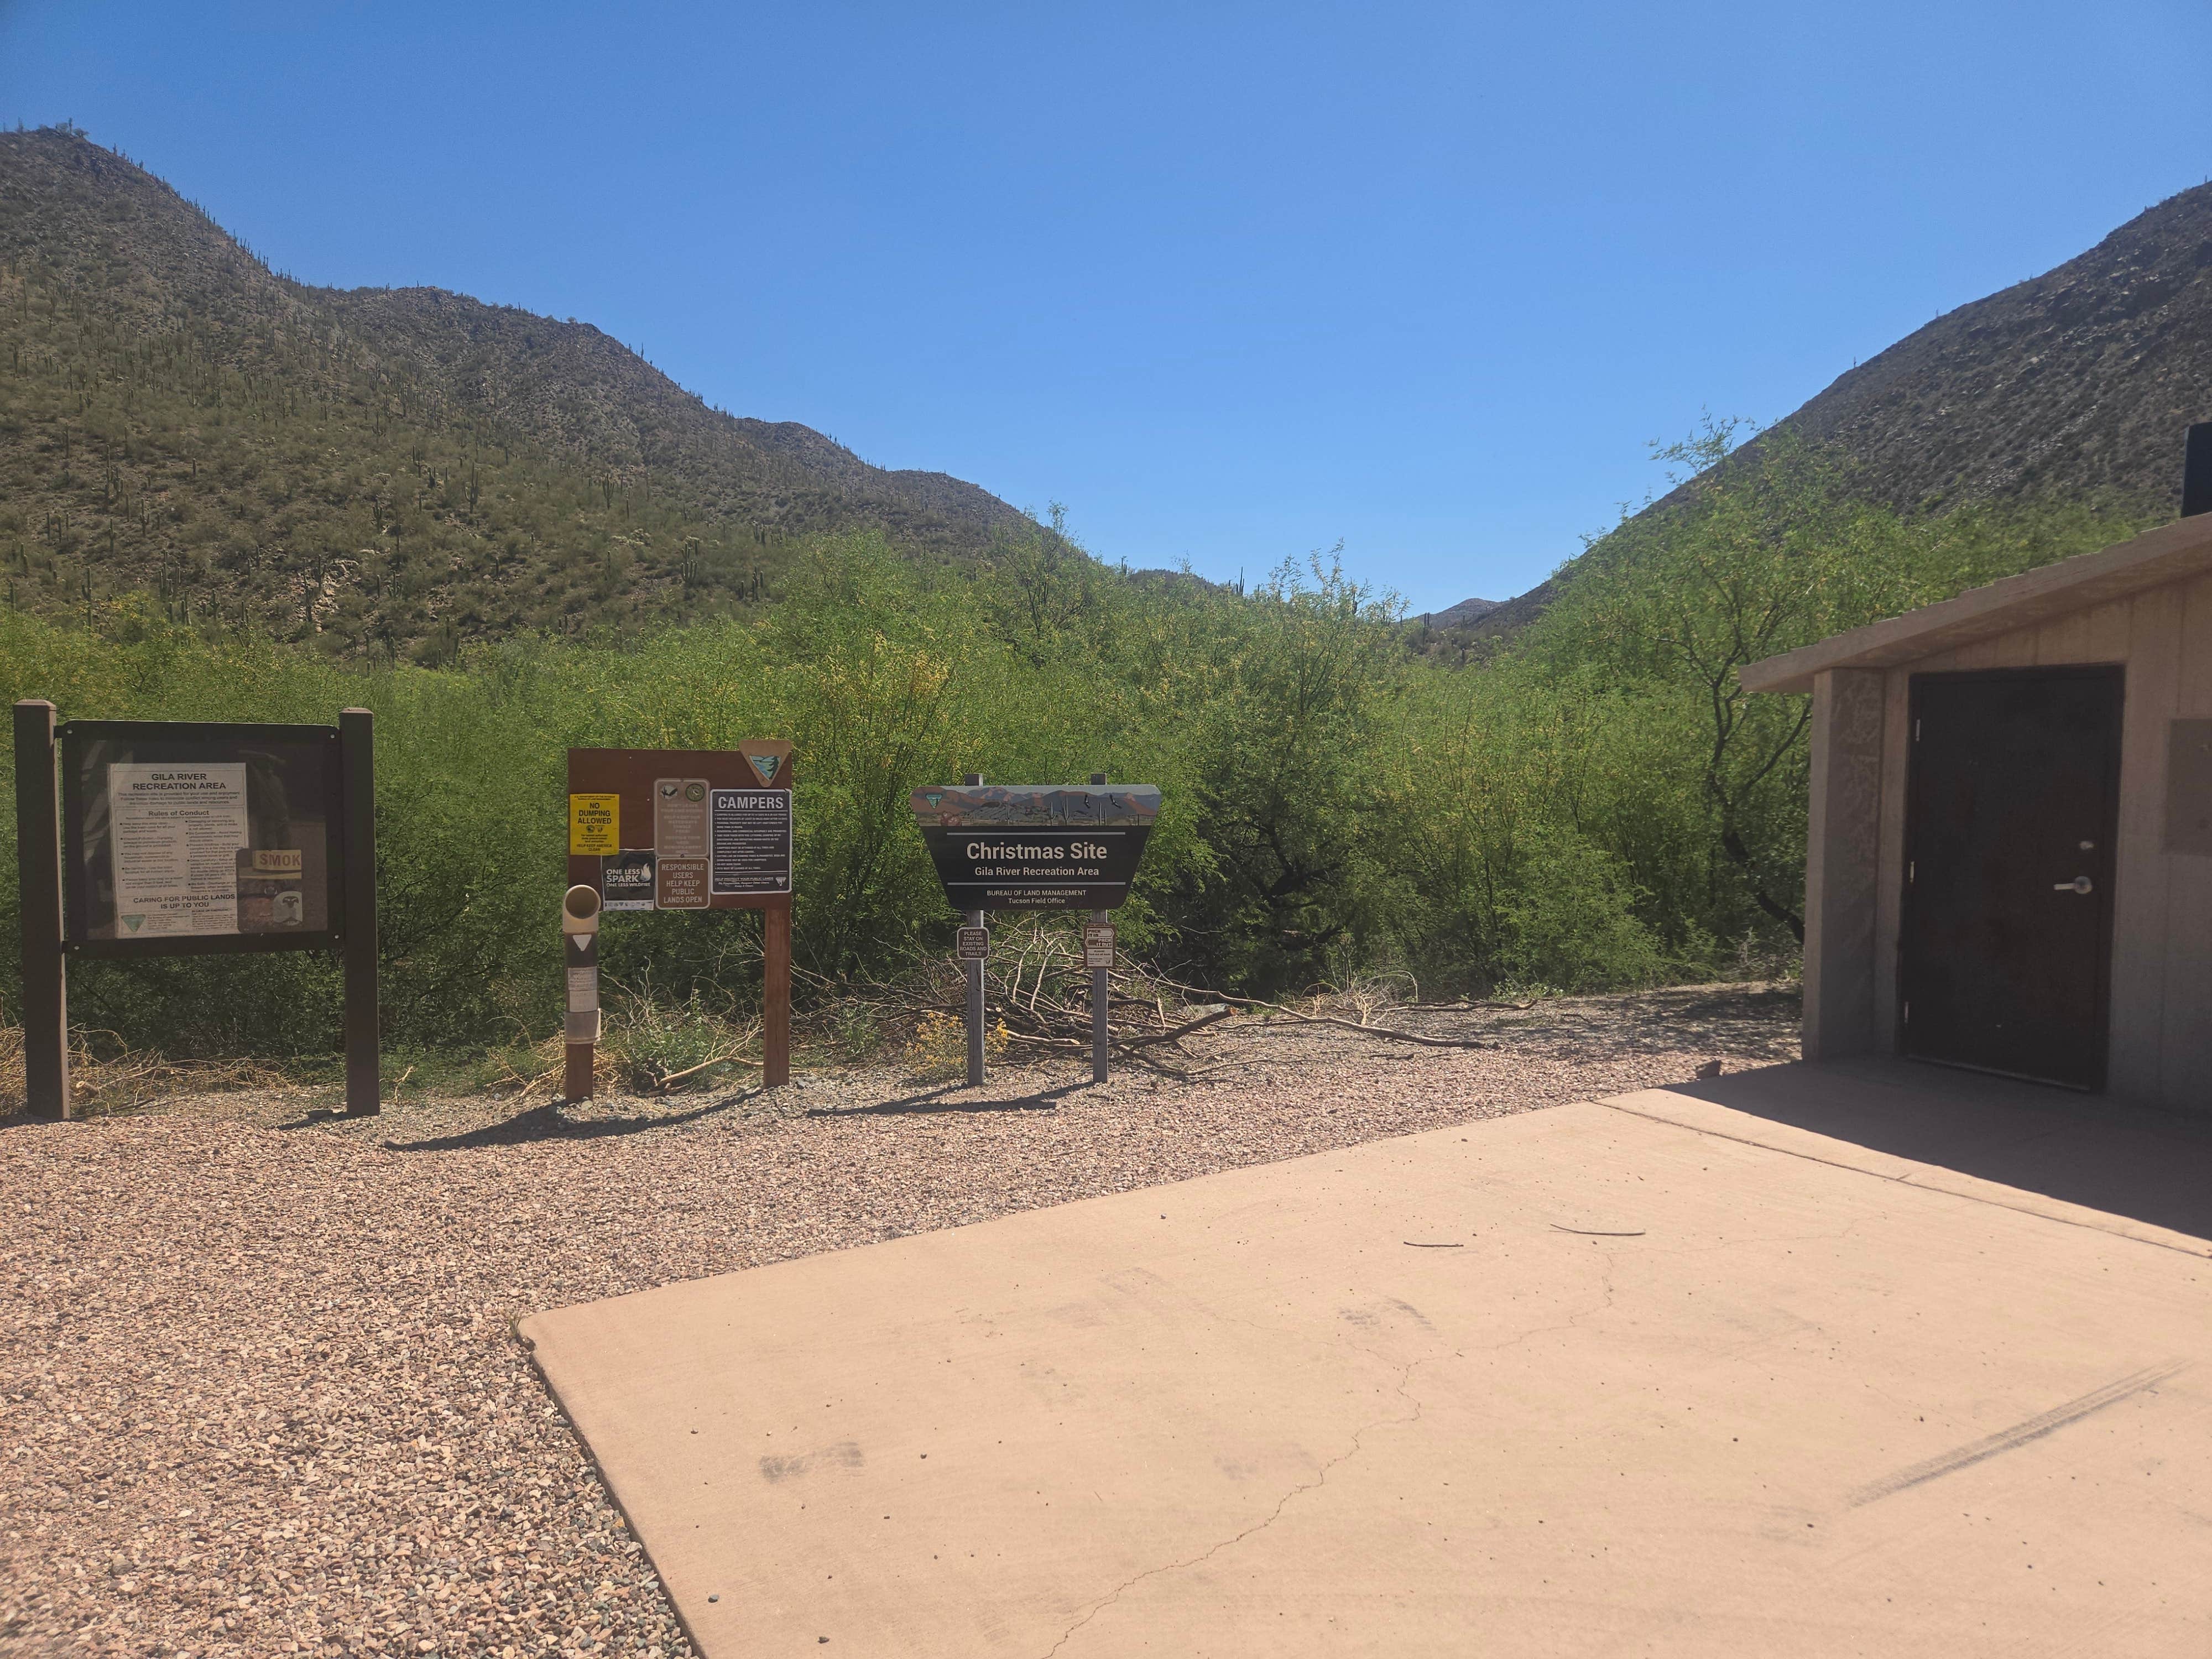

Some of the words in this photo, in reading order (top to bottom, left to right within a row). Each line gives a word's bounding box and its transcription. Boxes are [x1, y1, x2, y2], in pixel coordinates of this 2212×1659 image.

[718, 797, 784, 809] CAMPERS
[967, 842, 1064, 859] Christmas
[1070, 842, 1107, 859] Site
[259, 853, 300, 866] SMOK
[975, 867, 993, 876] Gila
[996, 867, 1020, 875] River
[1023, 867, 1074, 875] Recreation
[1077, 867, 1099, 875] Area
